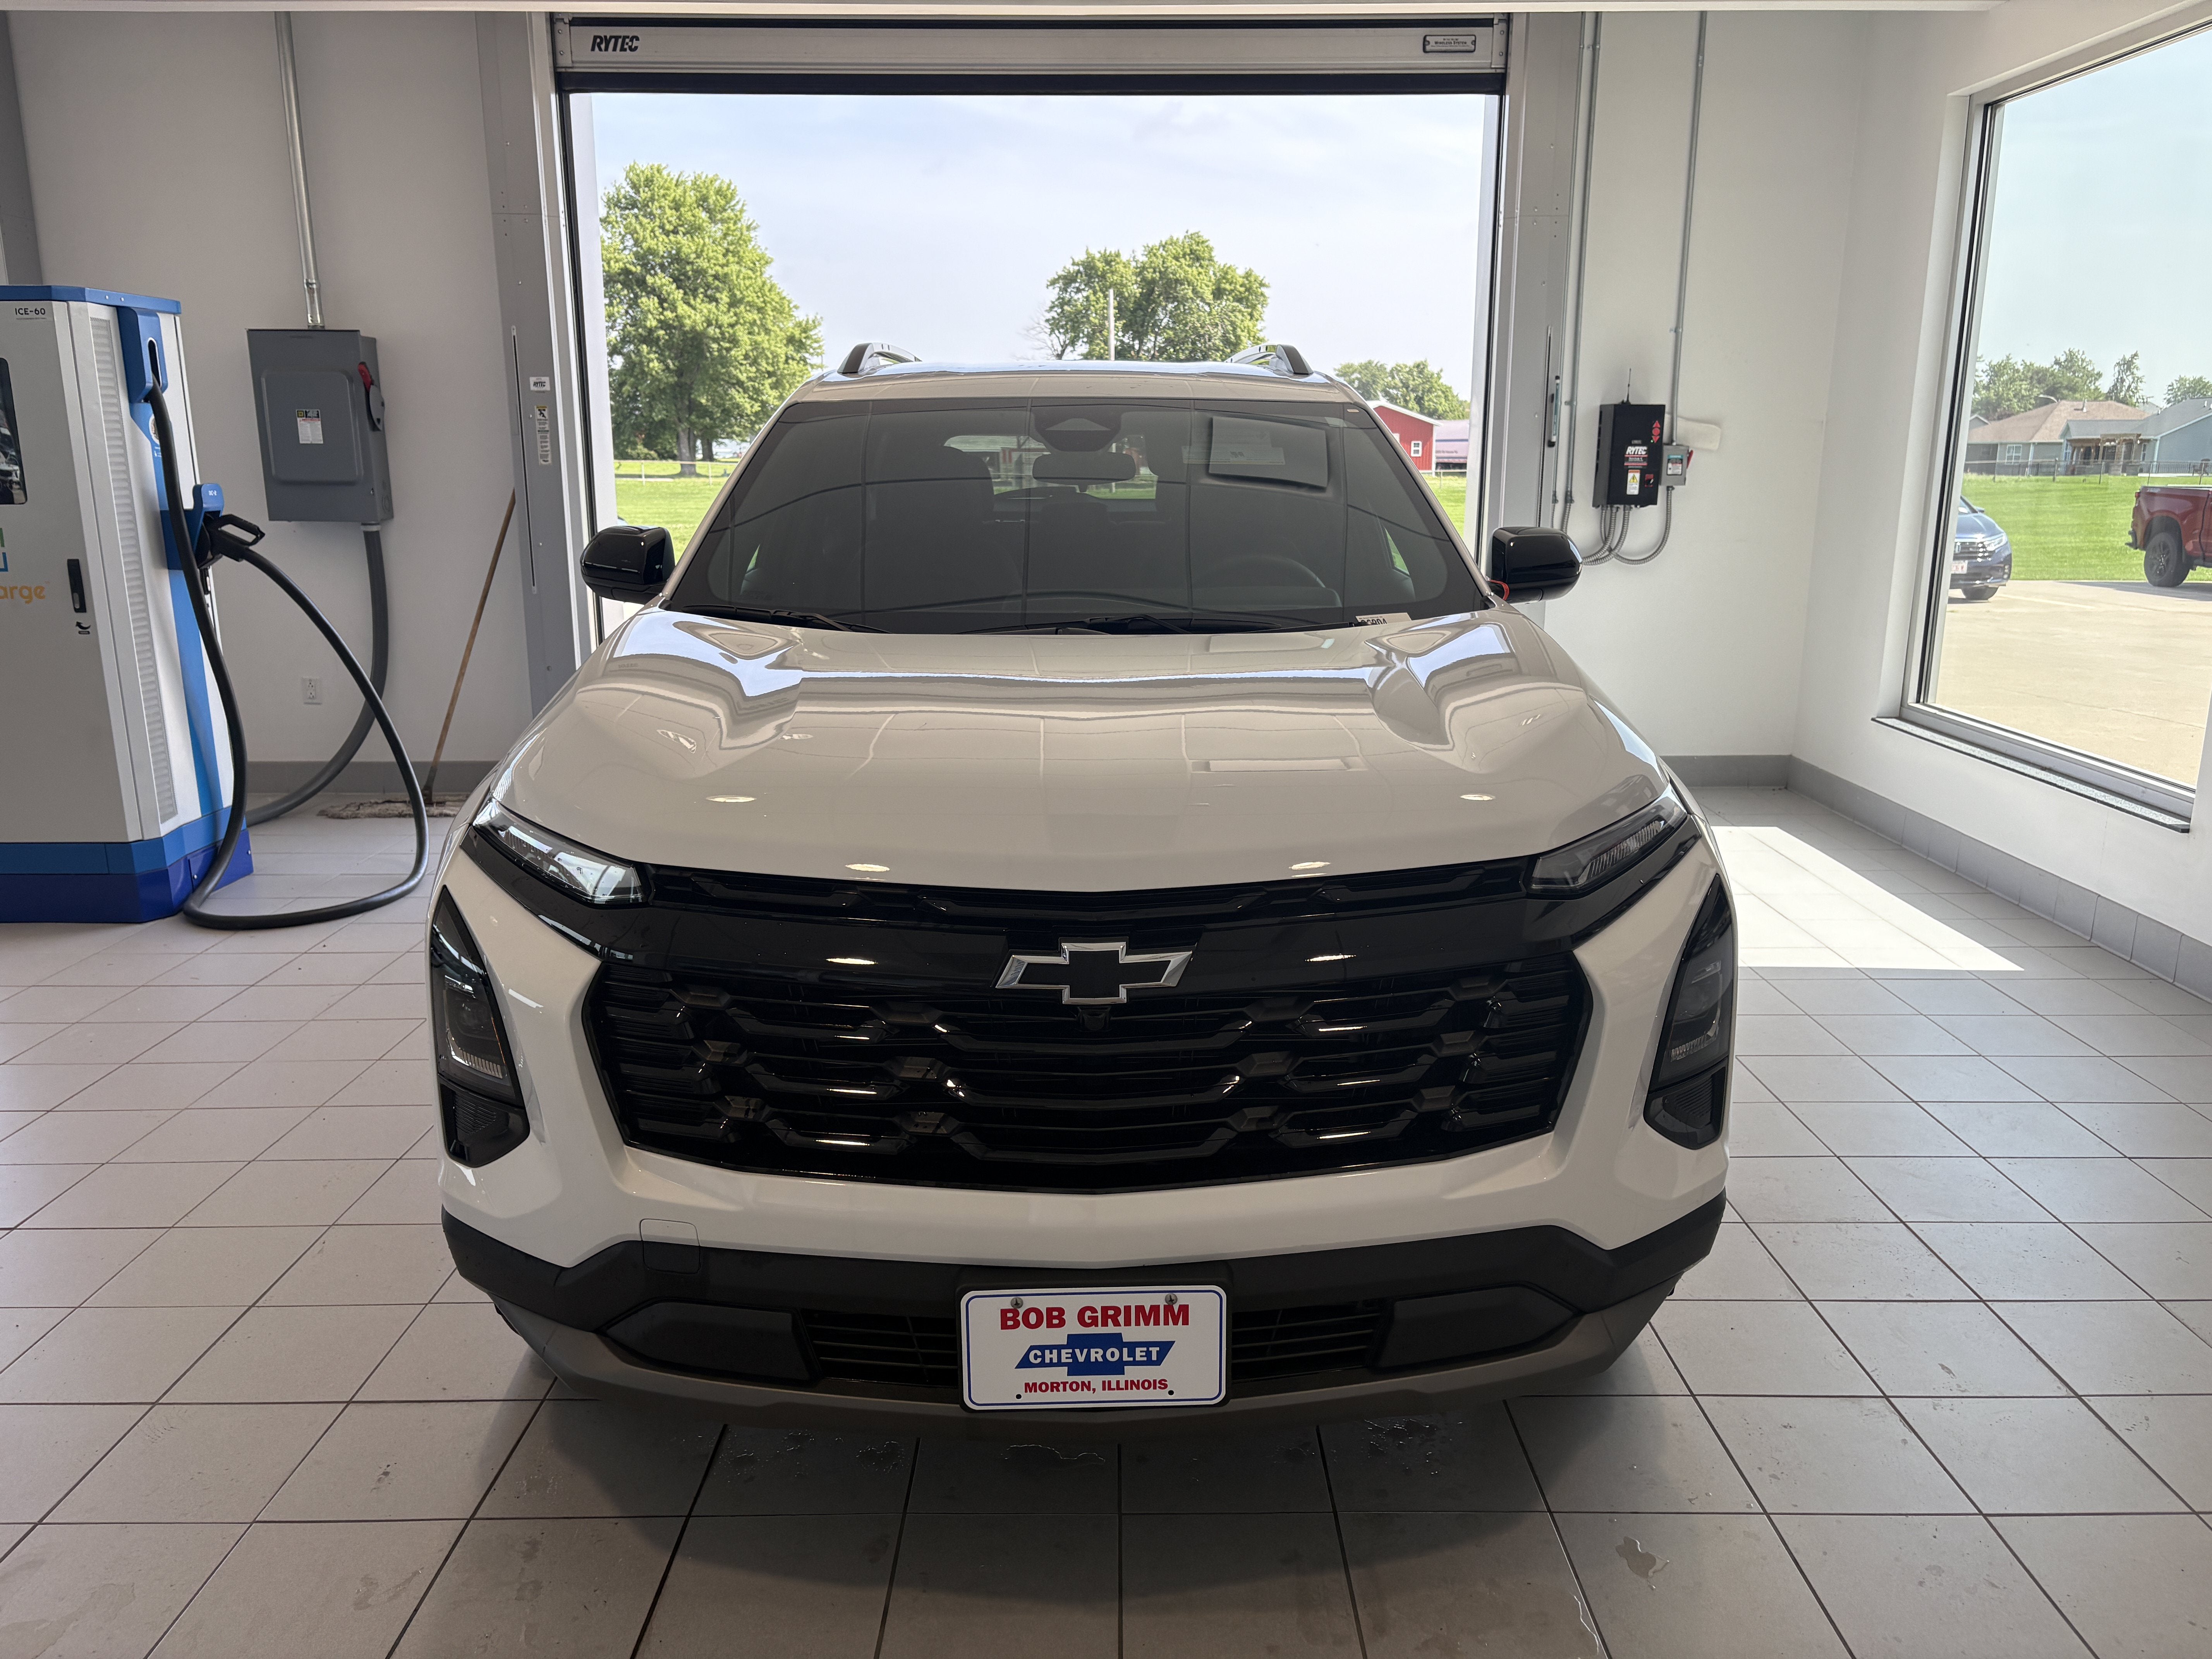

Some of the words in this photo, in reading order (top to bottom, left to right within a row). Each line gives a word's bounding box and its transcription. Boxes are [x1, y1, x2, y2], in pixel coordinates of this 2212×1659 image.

[591, 35, 640, 52] RYTEC
[1626, 446, 1647, 455] RYTEC
[1000, 1307, 1066, 1330] BOB
[1077, 1304, 1189, 1328] GRIMM
[1029, 1347, 1160, 1364] CHEVROLET
[1024, 1381, 1096, 1394] MORTON,
[1102, 1379, 1168, 1391] ILLINOIS
